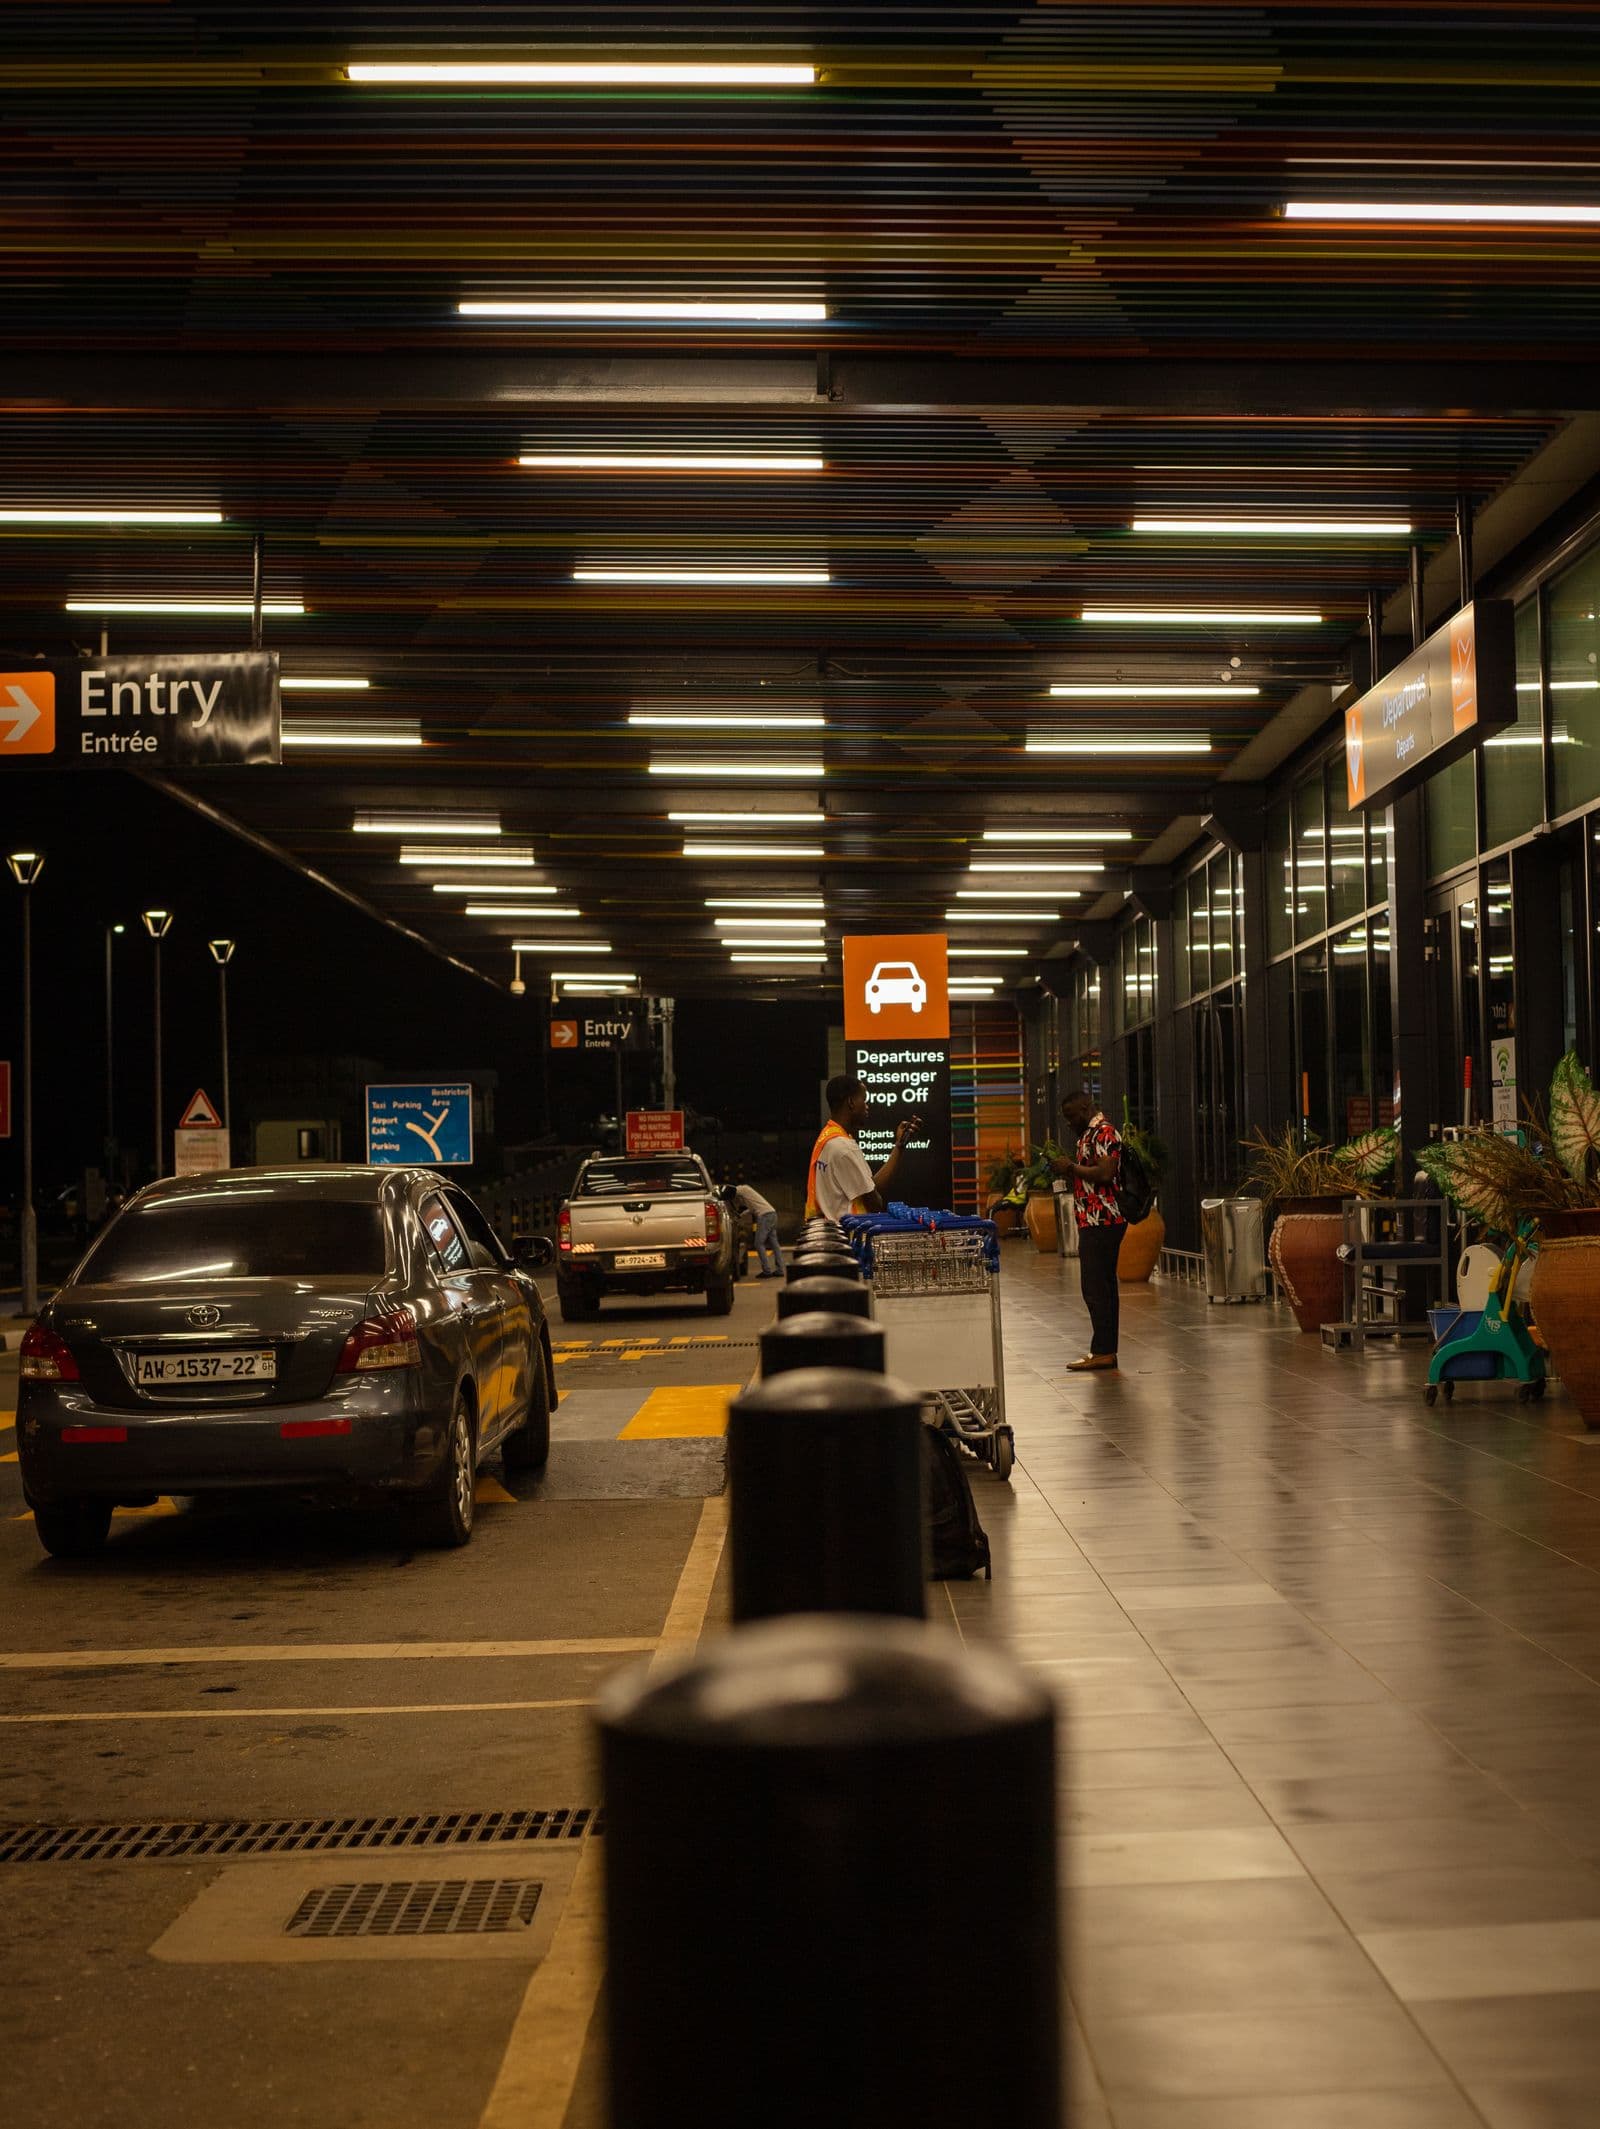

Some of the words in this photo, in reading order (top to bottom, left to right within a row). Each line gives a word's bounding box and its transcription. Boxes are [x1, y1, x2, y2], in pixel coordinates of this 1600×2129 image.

[80, 668, 223, 729] Entry
[1383, 672, 1427, 731] Departures
[80, 728, 158, 754] Entrée
[584, 1019, 631, 1040] Entry
[584, 1039, 611, 1049] Entrée
[856, 1049, 945, 1067] Departures
[856, 1069, 937, 1087] Passenger
[901, 1088, 929, 1104] Off
[392, 1101, 422, 1111] Parking
[371, 1116, 399, 1126] Airport
[858, 1129, 895, 1141] Départs
[371, 1142, 401, 1152] Parking
[143, 1360, 165, 1379] AW
[175, 1356, 256, 1378] 1537-22
[262, 1361, 274, 1371] GH
